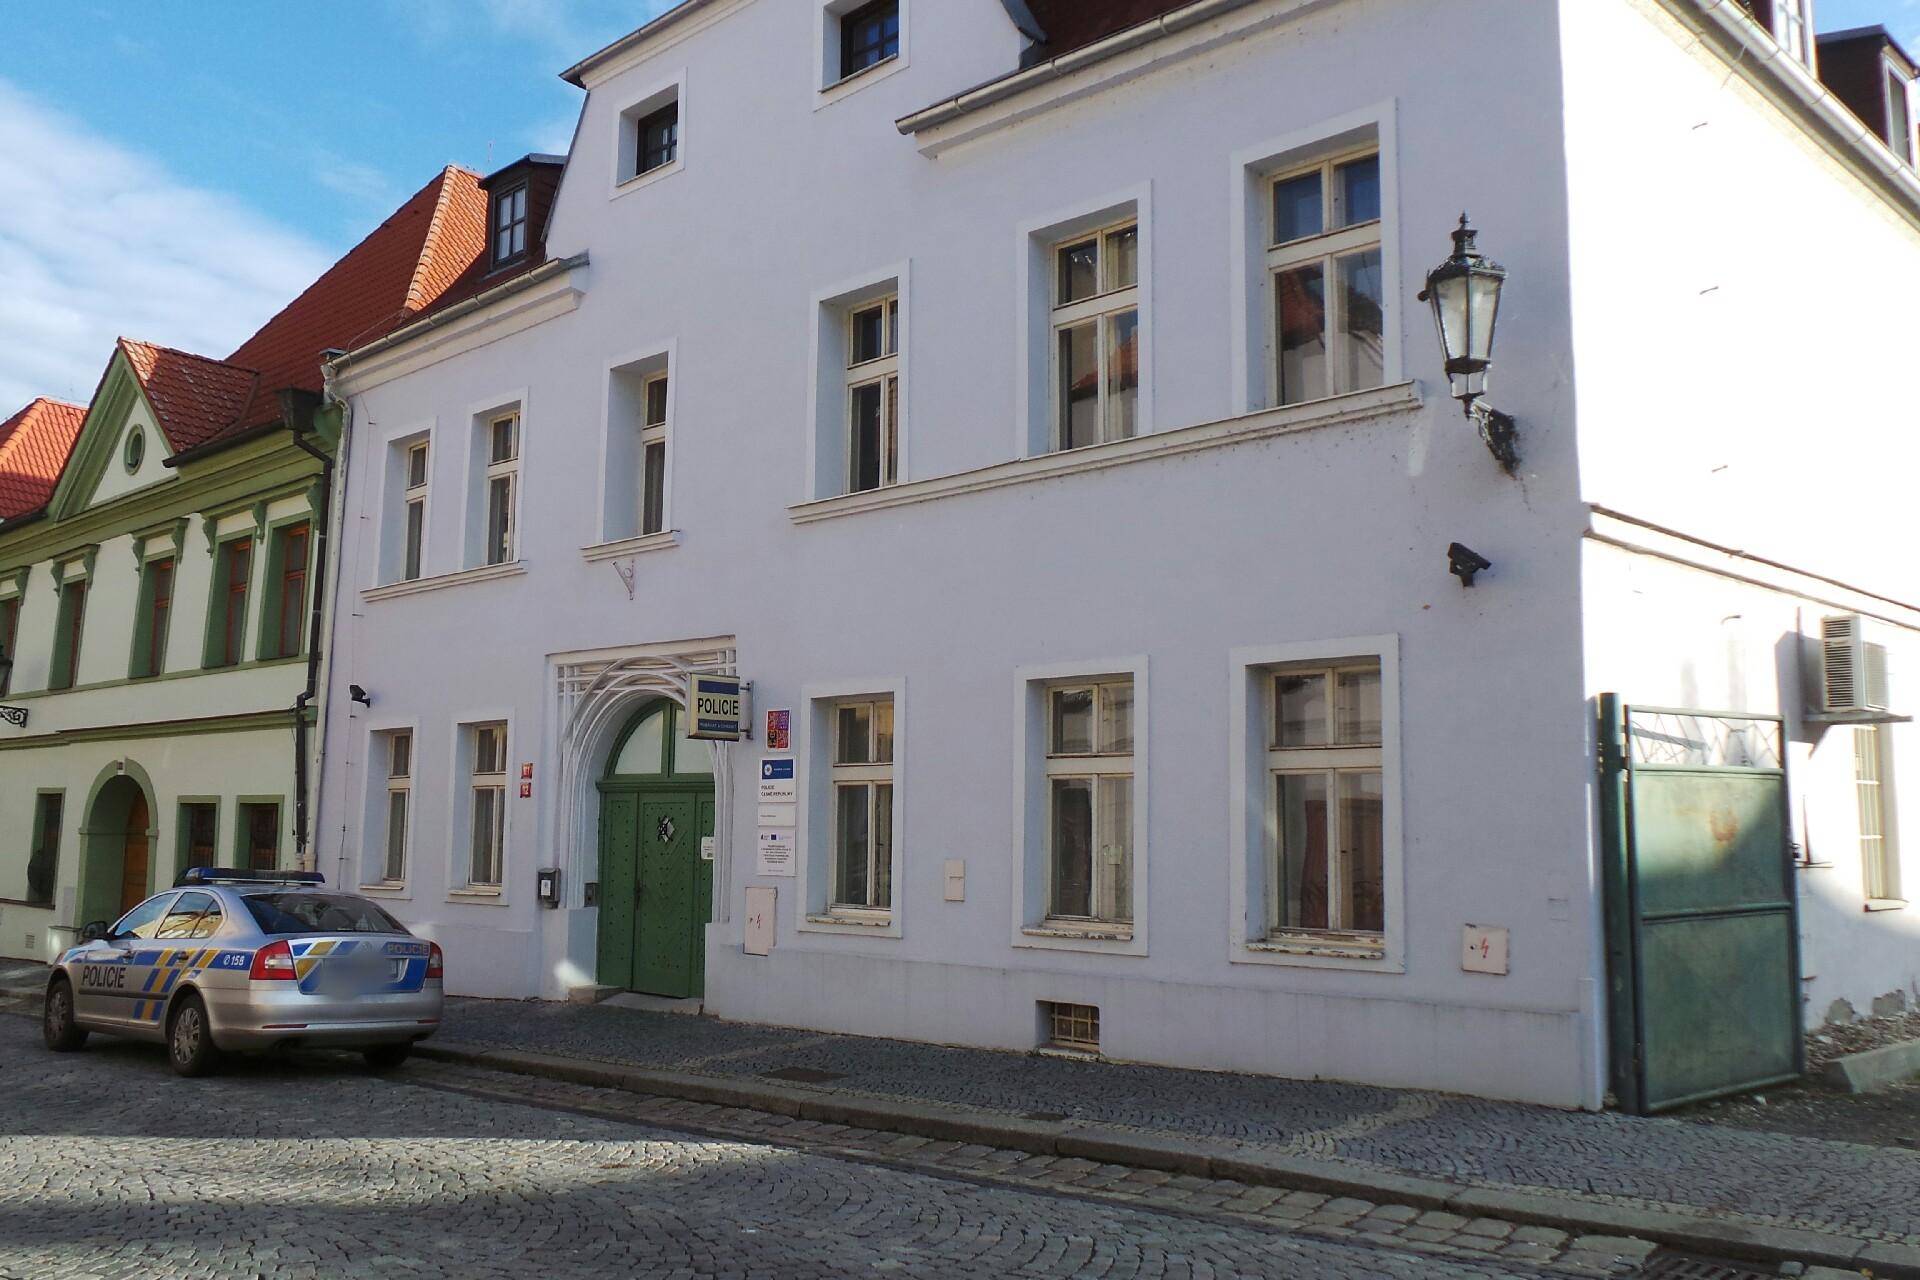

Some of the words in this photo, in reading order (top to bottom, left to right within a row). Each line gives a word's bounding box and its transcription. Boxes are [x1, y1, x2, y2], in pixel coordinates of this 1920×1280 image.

[697, 698, 739, 716] POLICIE
[389, 943, 430, 957] POLICIE
[231, 955, 245, 966] 158
[81, 965, 126, 988] POLICIE
